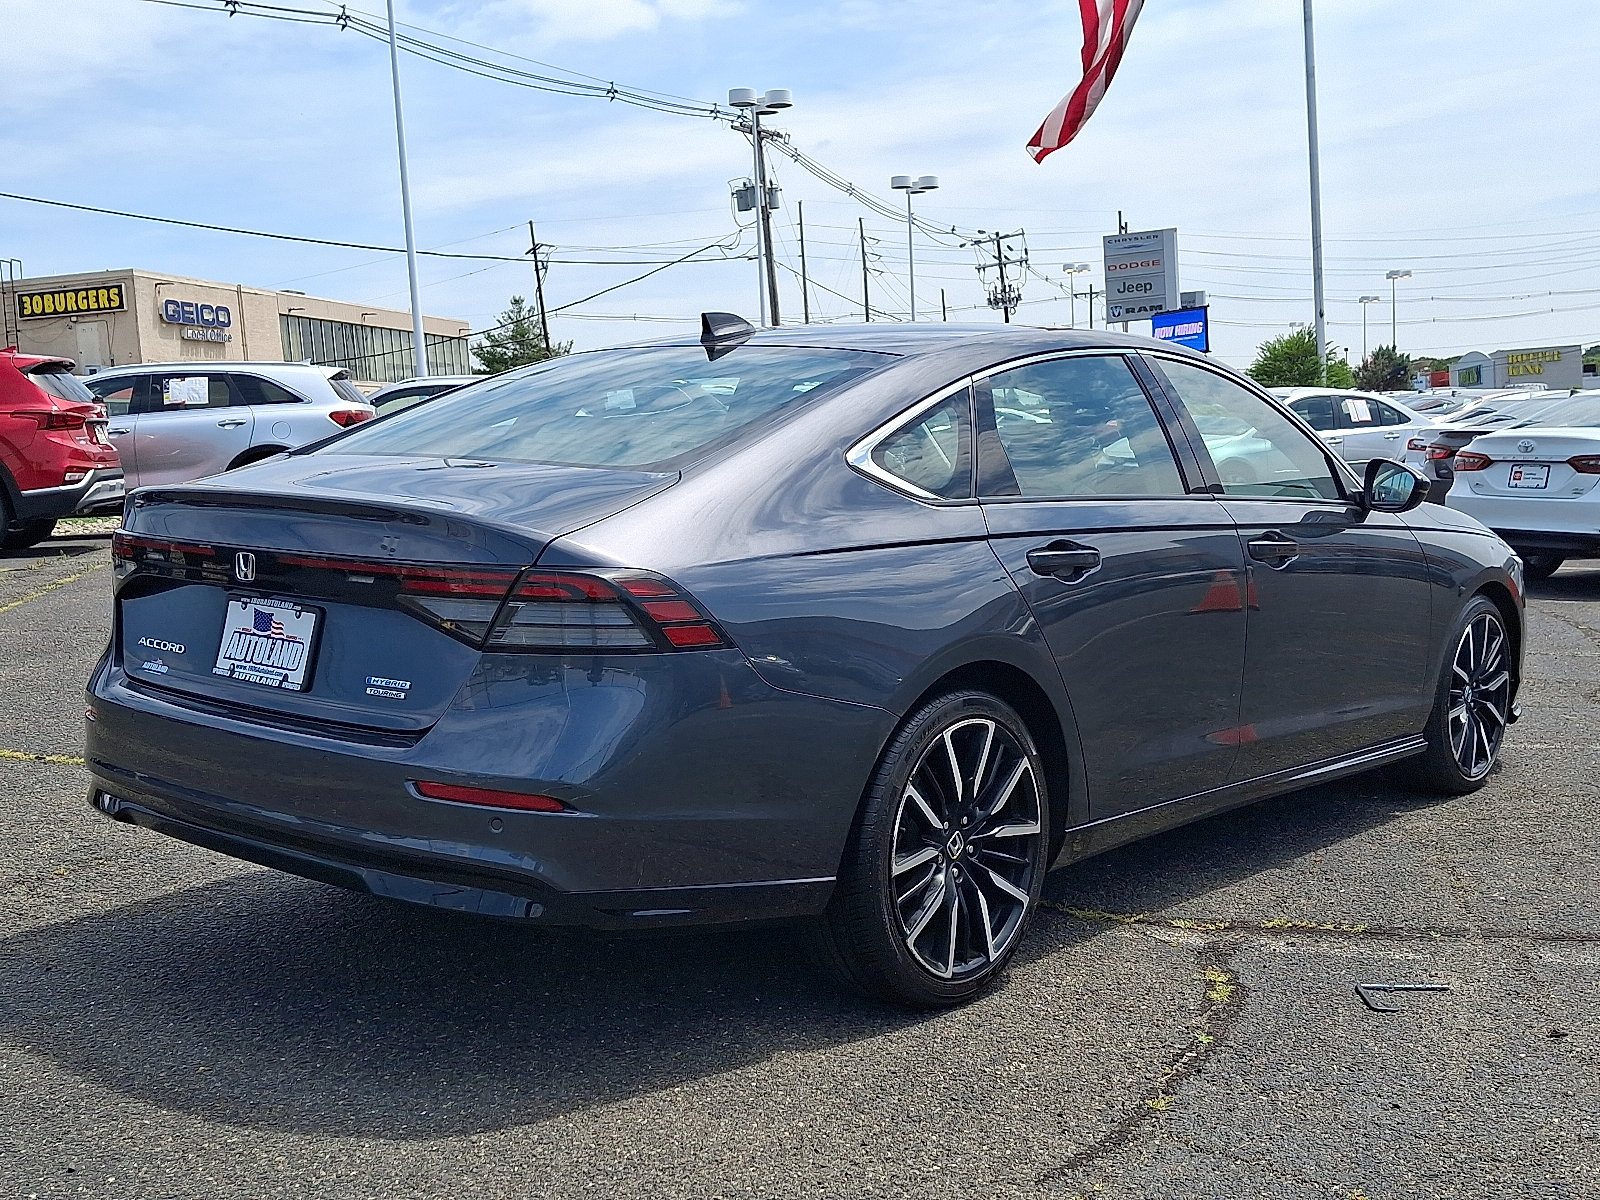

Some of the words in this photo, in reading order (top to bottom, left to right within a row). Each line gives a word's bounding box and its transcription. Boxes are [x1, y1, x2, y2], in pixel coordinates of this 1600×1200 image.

[1107, 234, 1159, 245] CHRYSLER
[1107, 259, 1161, 271] DODGE
[1116, 281, 1153, 294] Jeep
[164, 299, 232, 328] GEICO
[1125, 304, 1163, 314] RAM
[187, 327, 208, 341] Local
[210, 329, 233, 343] Office
[1154, 325, 1174, 339] NOW
[1174, 321, 1204, 336] HIRING
[1507, 350, 1562, 365] BOTTLE
[1507, 364, 1544, 377] KING
[138, 636, 185, 653] ACCORD
[224, 632, 304, 670] AUTOLAND
[232, 671, 280, 687] AUTOLAND
[372, 678, 408, 688] HYBRID
[369, 688, 402, 698] TOURING
